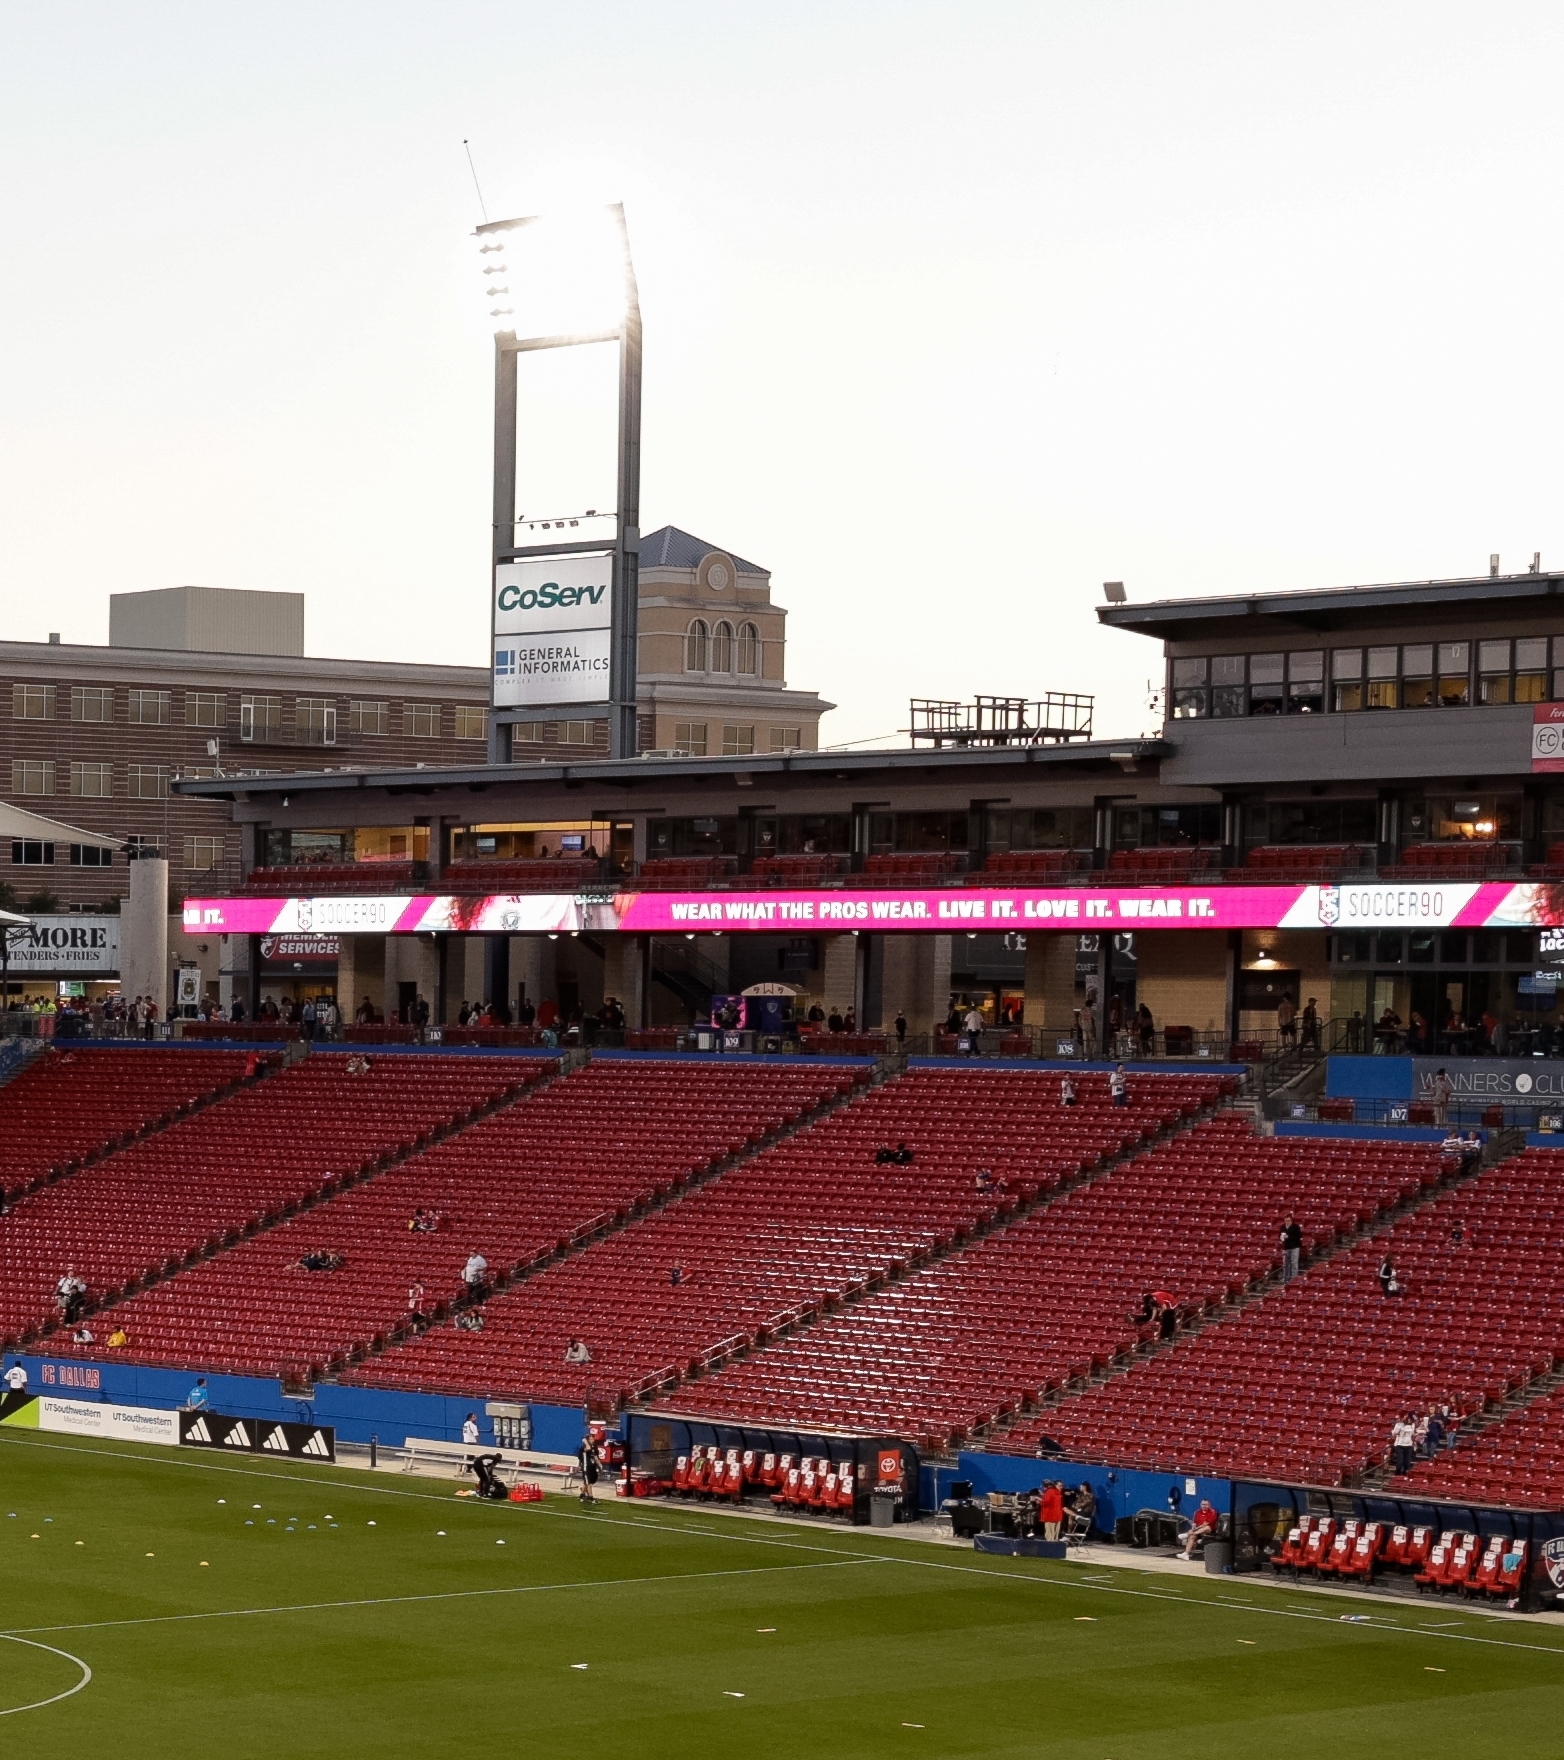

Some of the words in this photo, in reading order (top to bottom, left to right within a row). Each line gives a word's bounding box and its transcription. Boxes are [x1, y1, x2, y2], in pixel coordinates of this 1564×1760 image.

[498, 582, 606, 611] CoServ
[519, 646, 580, 661] GENERAL
[519, 658, 608, 674] INFORMATICS
[672, 903, 722, 919] WEAR
[725, 903, 775, 919] WHAT
[779, 903, 813, 919] THE
[819, 902, 868, 919] PROS
[871, 901, 931, 918] WEAR.
[938, 901, 985, 918] LIVE
[991, 901, 1018, 918] IT.
[1024, 900, 1079, 918] LOVE
[1085, 900, 1113, 917] IT.
[1119, 899, 1182, 917] WEAR
[1189, 899, 1216, 917] IT.
[1349, 892, 1443, 916] SOCCER90
[320, 903, 386, 924] SOCCER90
[29, 927, 106, 949] MORE
[7, 950, 59, 960] TENDERS
[66, 950, 100, 961] FRIES
[1058, 1044, 1074, 1055] 108
[1421, 1073, 1512, 1093] WNNERS
[1390, 1109, 1406, 1120] 107
[42, 1364, 55, 1385] FC
[59, 1366, 100, 1389] DALLAS
[64, 1416, 83, 1425] Medical
[84, 1418, 101, 1427] Center
[133, 1425, 153, 1434] Medical
[154, 1427, 172, 1436] Center
